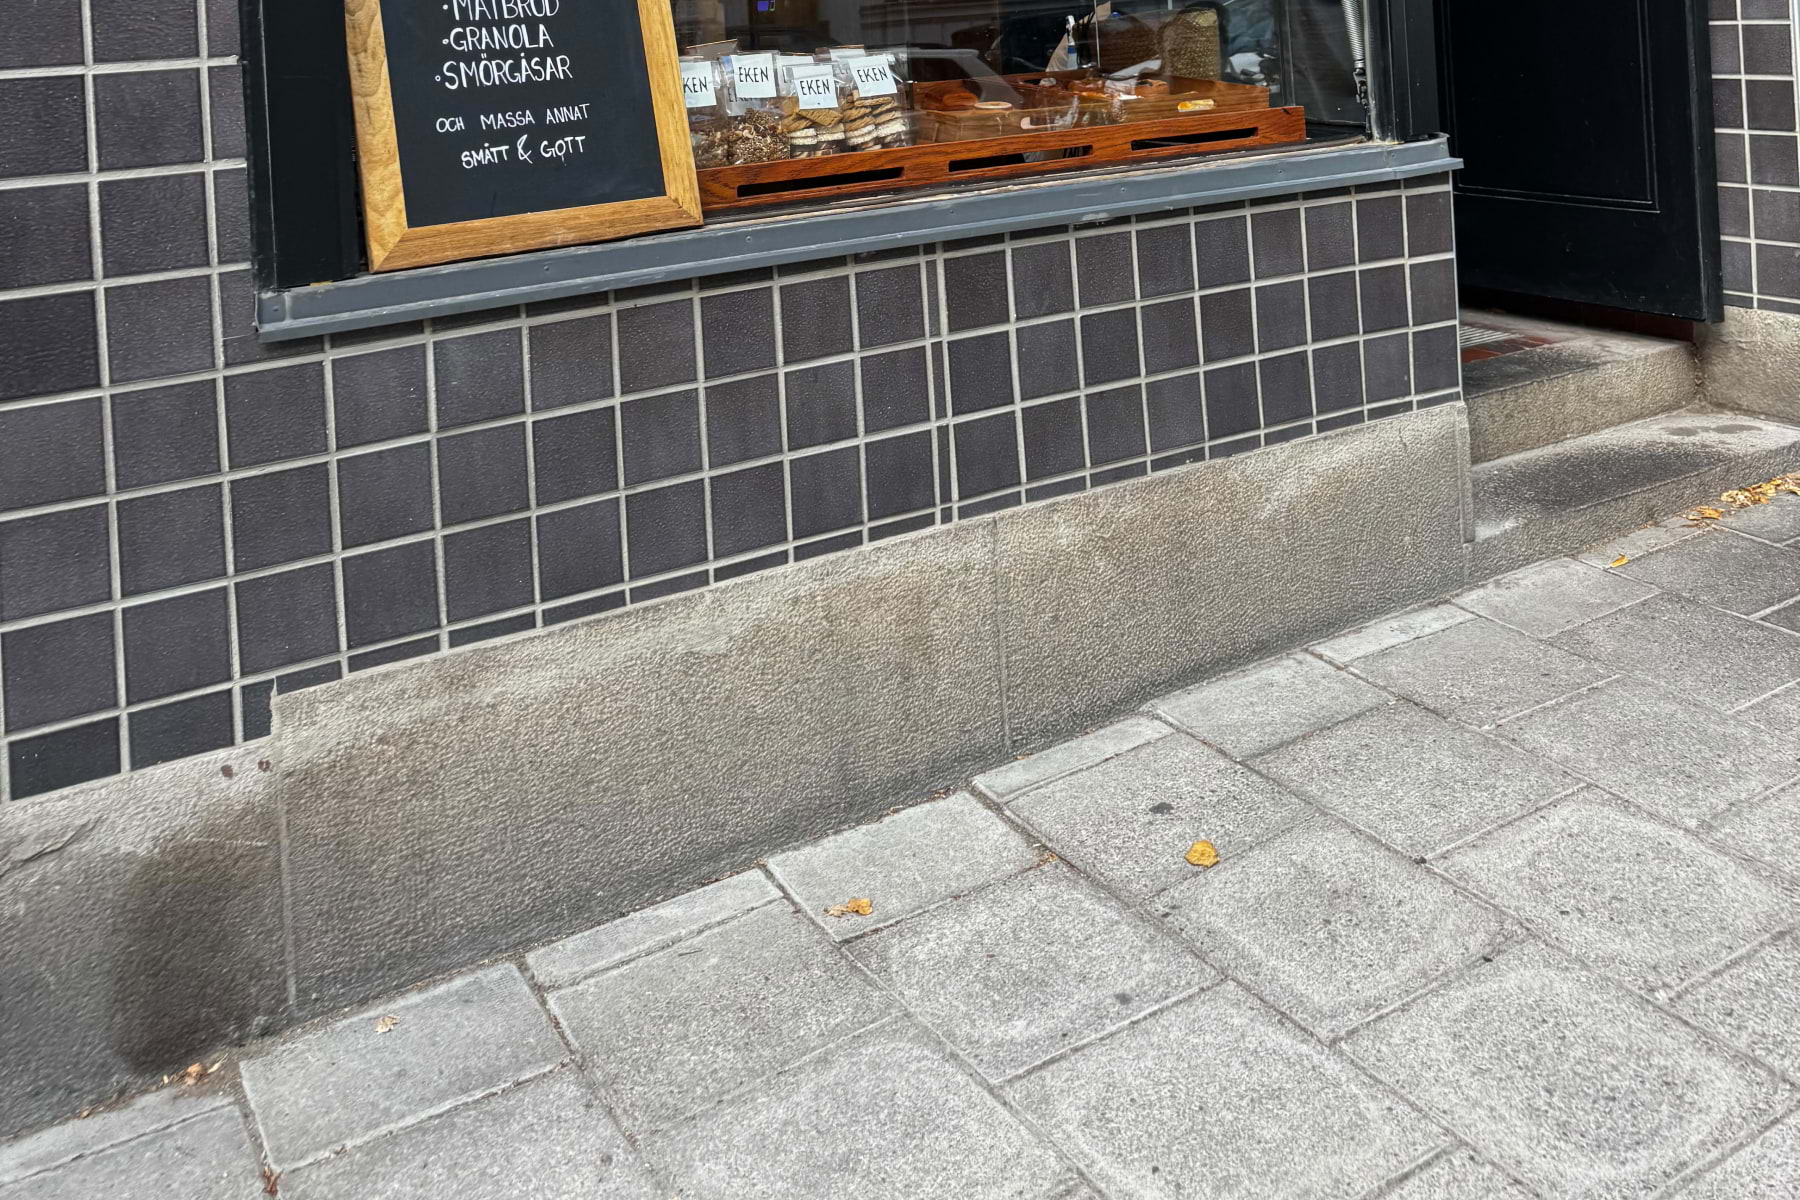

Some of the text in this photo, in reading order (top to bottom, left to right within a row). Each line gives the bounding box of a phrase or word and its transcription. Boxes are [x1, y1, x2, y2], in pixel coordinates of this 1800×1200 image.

[450, 23, 554, 52] GRANOLA
[442, 52, 573, 90] SMÖRGÅSAR
[738, 66, 769, 83] EKEN
[856, 66, 889, 83] EKEN
[682, 76, 708, 94] KEN
[800, 78, 831, 96] EKEN
[435, 103, 591, 133] OCH MASSA ANNAT
[460, 134, 586, 169] SMÅTT & GOTT
